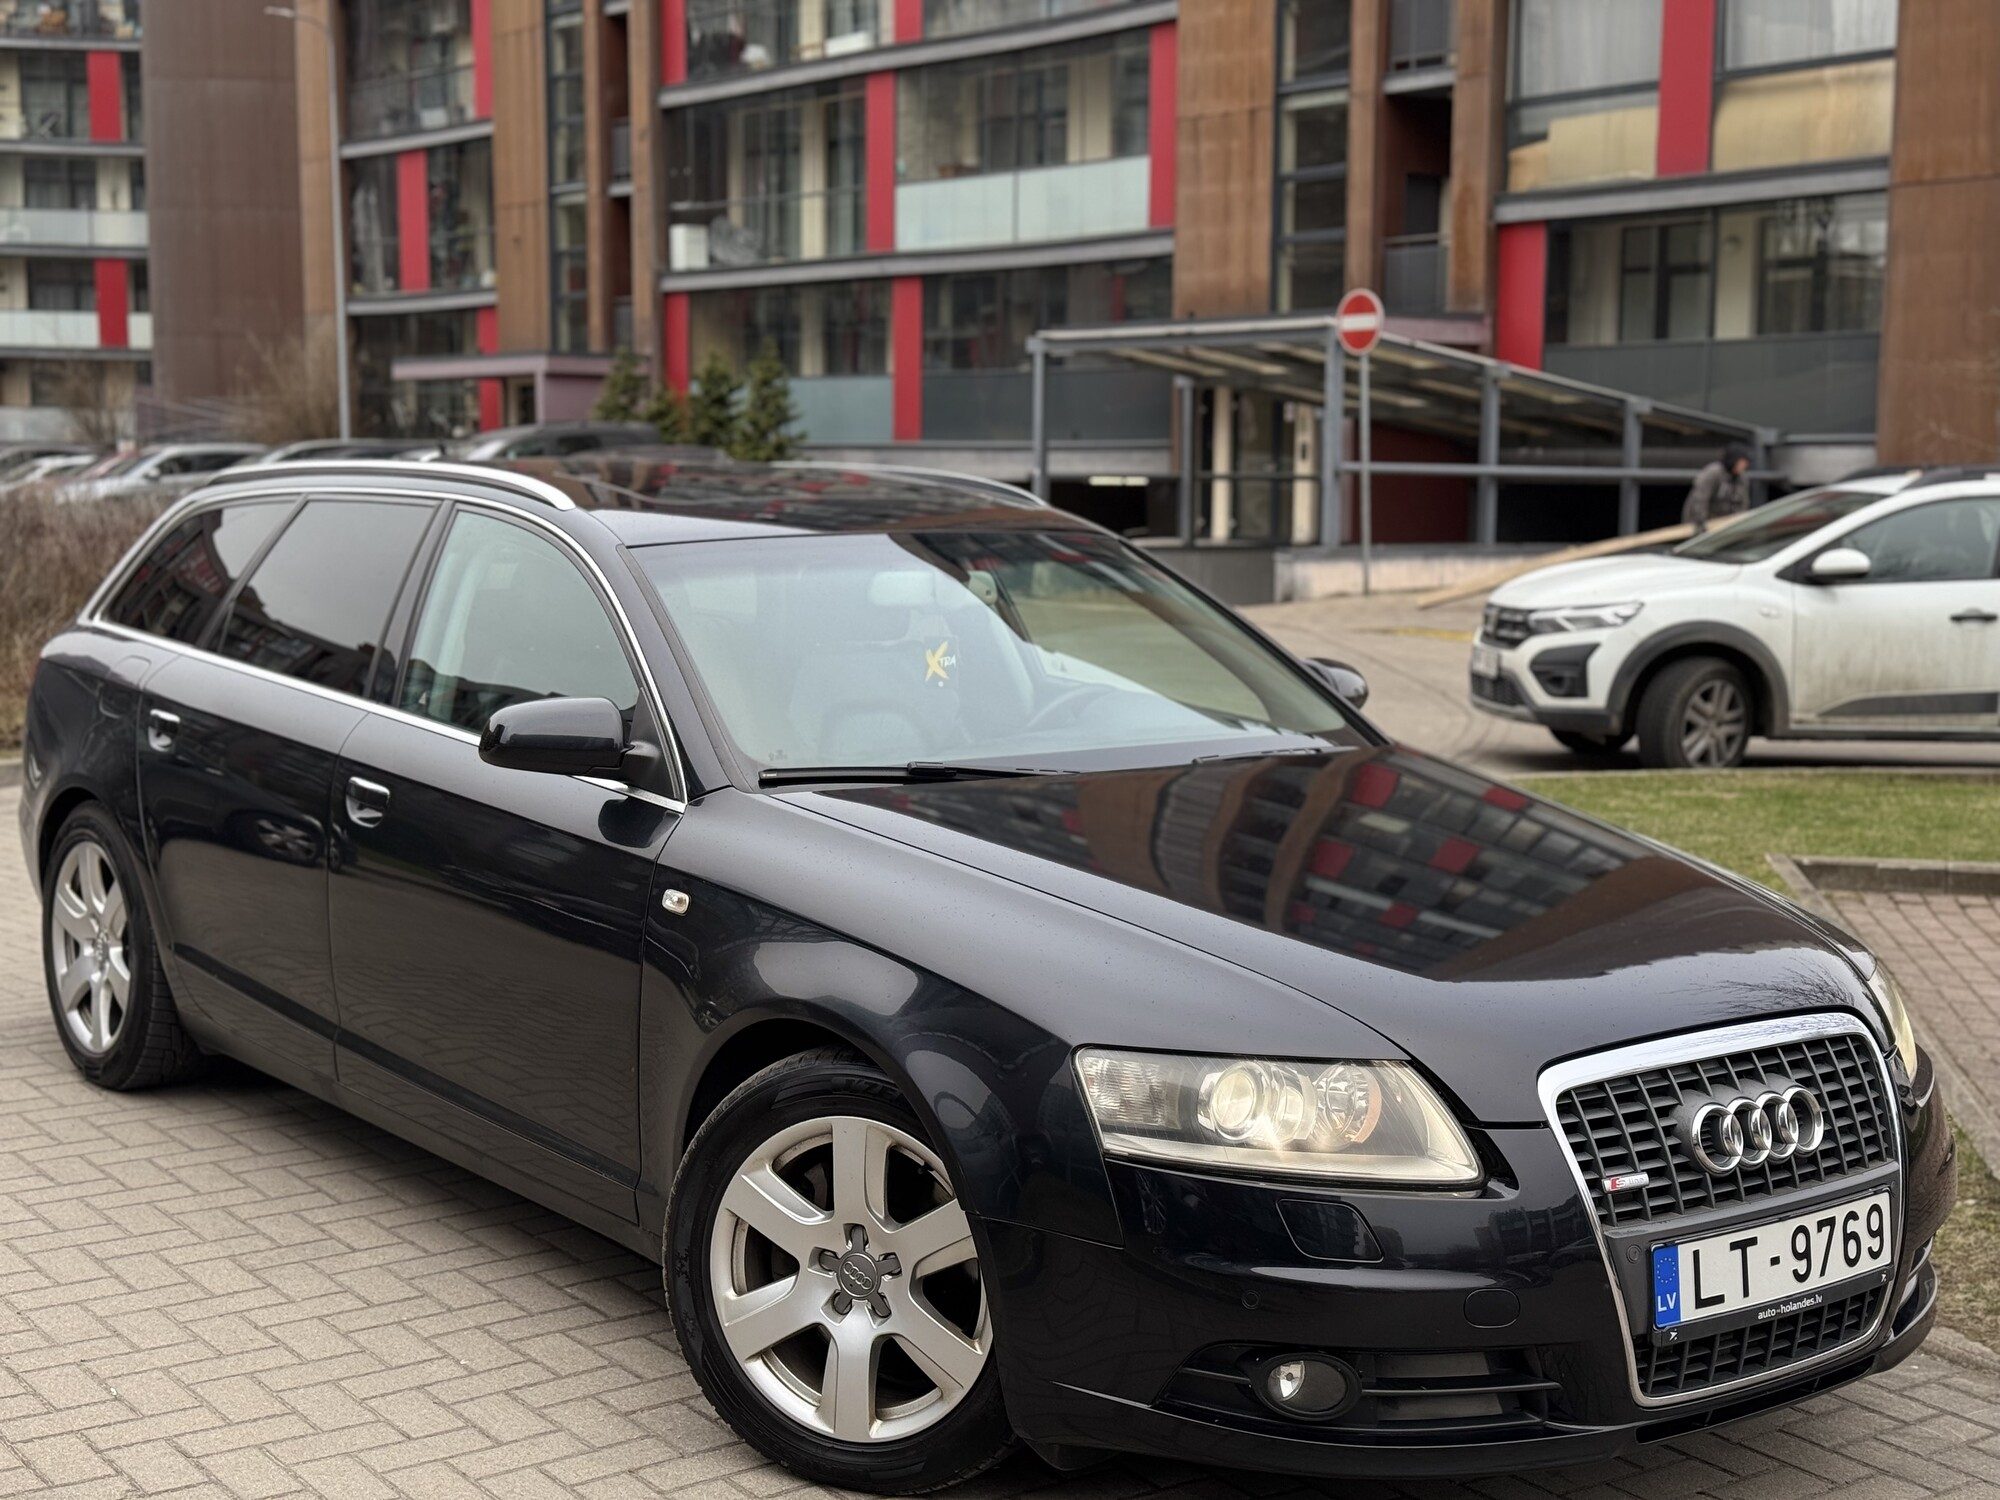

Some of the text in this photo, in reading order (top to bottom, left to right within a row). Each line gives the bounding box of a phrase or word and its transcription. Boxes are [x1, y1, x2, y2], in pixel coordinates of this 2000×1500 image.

[1692, 1203, 1885, 1310] LT-9769
[1657, 1292, 1677, 1312] LV
[1757, 1294, 1823, 1320] auto-holandes.lv
